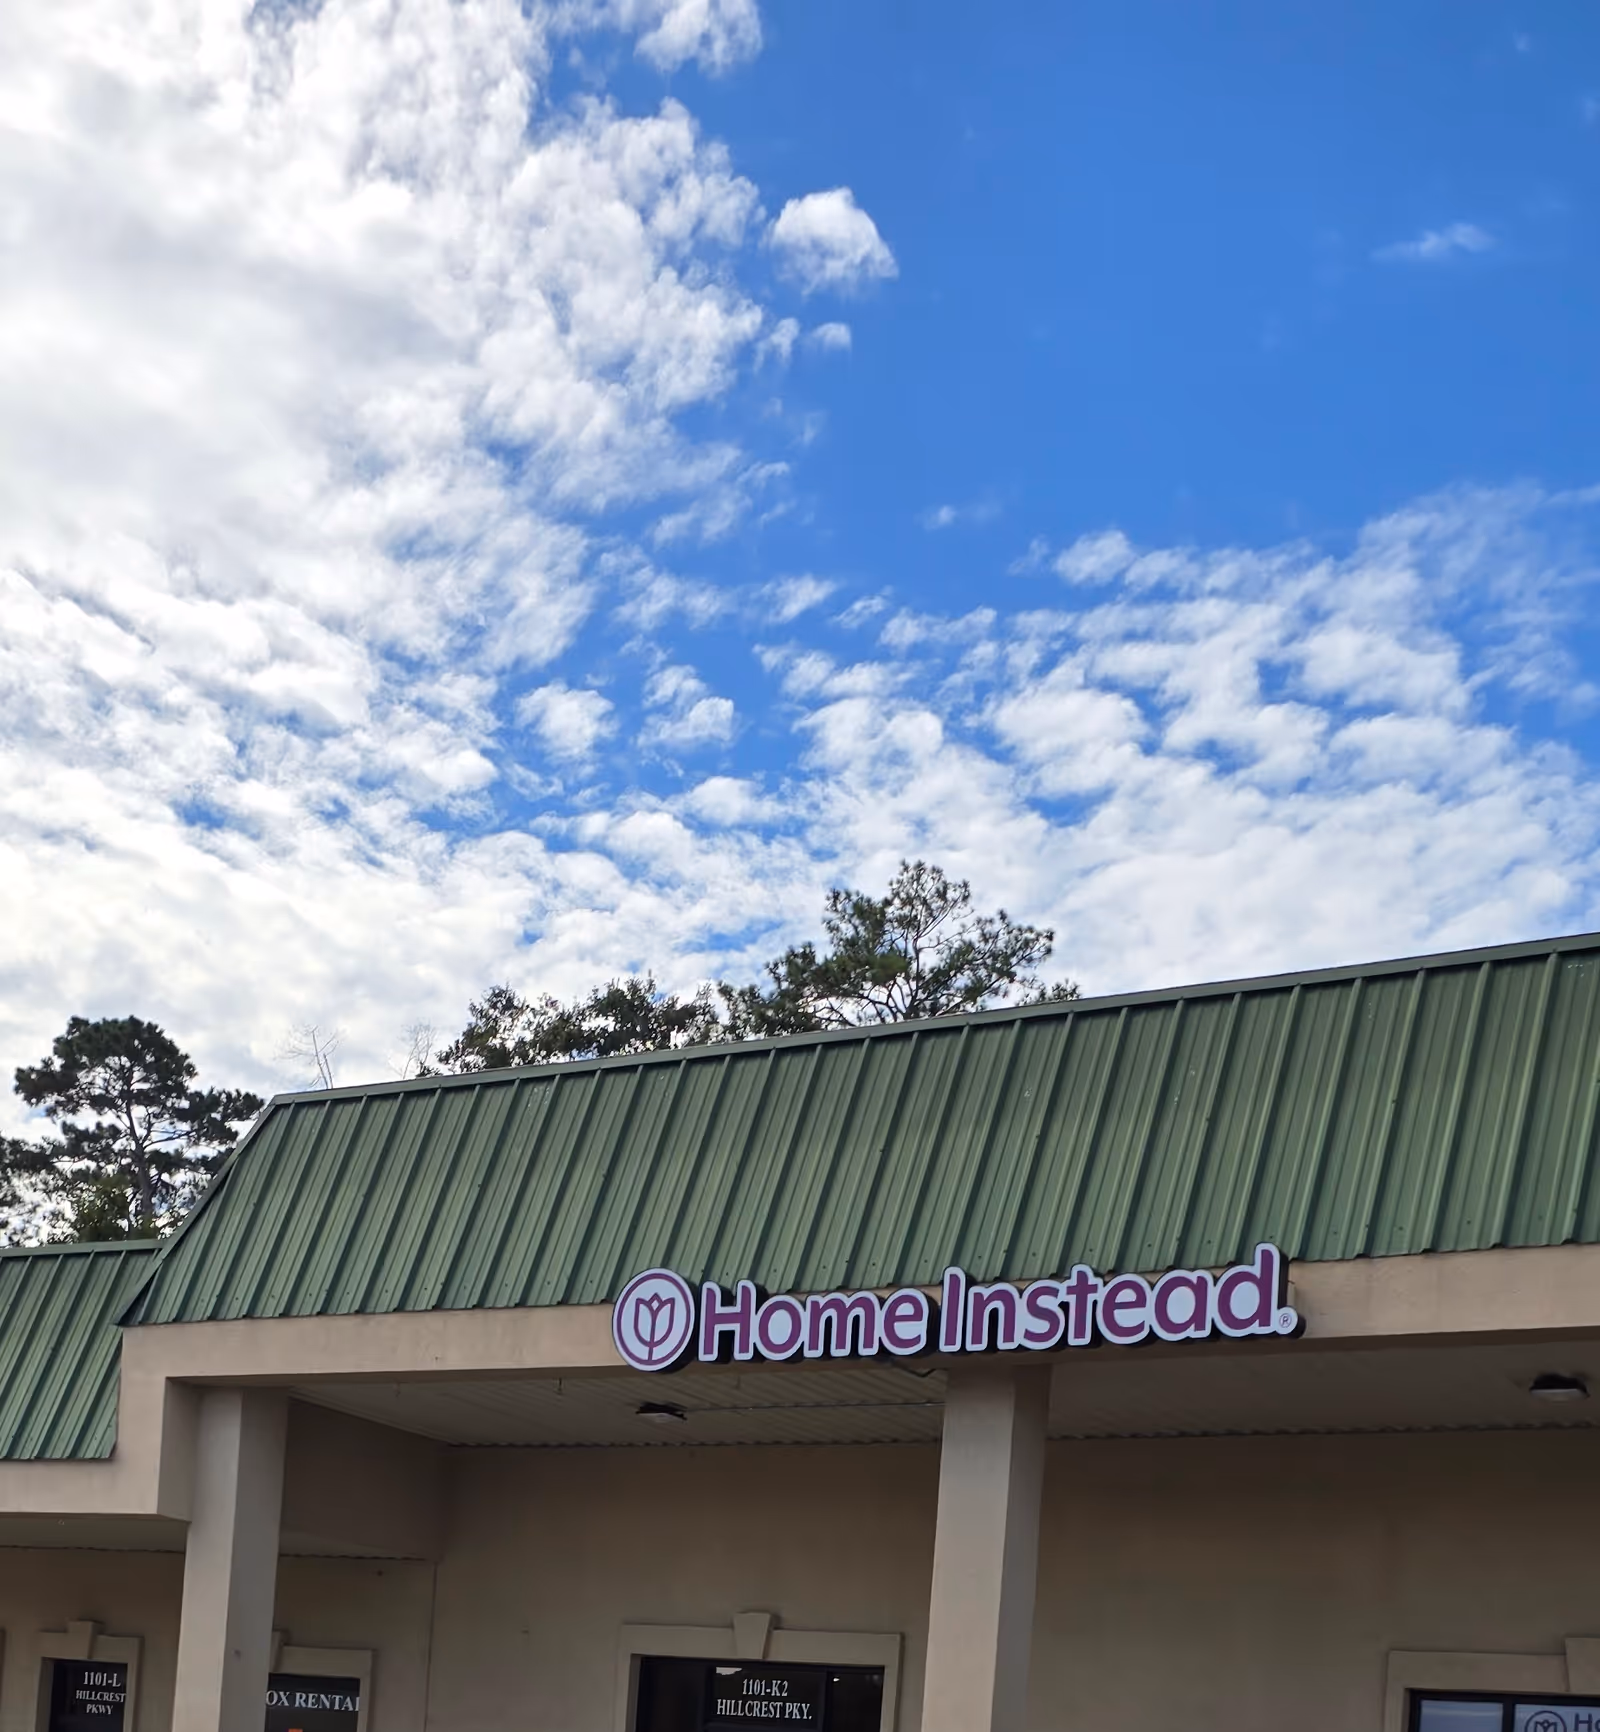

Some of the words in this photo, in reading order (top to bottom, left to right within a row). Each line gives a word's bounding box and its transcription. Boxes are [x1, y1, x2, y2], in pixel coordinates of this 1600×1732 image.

[703, 1285, 923, 1355] Home
[83, 1672, 122, 1687] 1101-L
[743, 1679, 788, 1697] 1101-K2
[76, 1690, 127, 1703] HILLCREST
[266, 1690, 290, 1707] OX
[86, 1704, 113, 1715] PKWY
[717, 1699, 783, 1718] HILLCREST
[784, 1702, 813, 1720] PKY.
